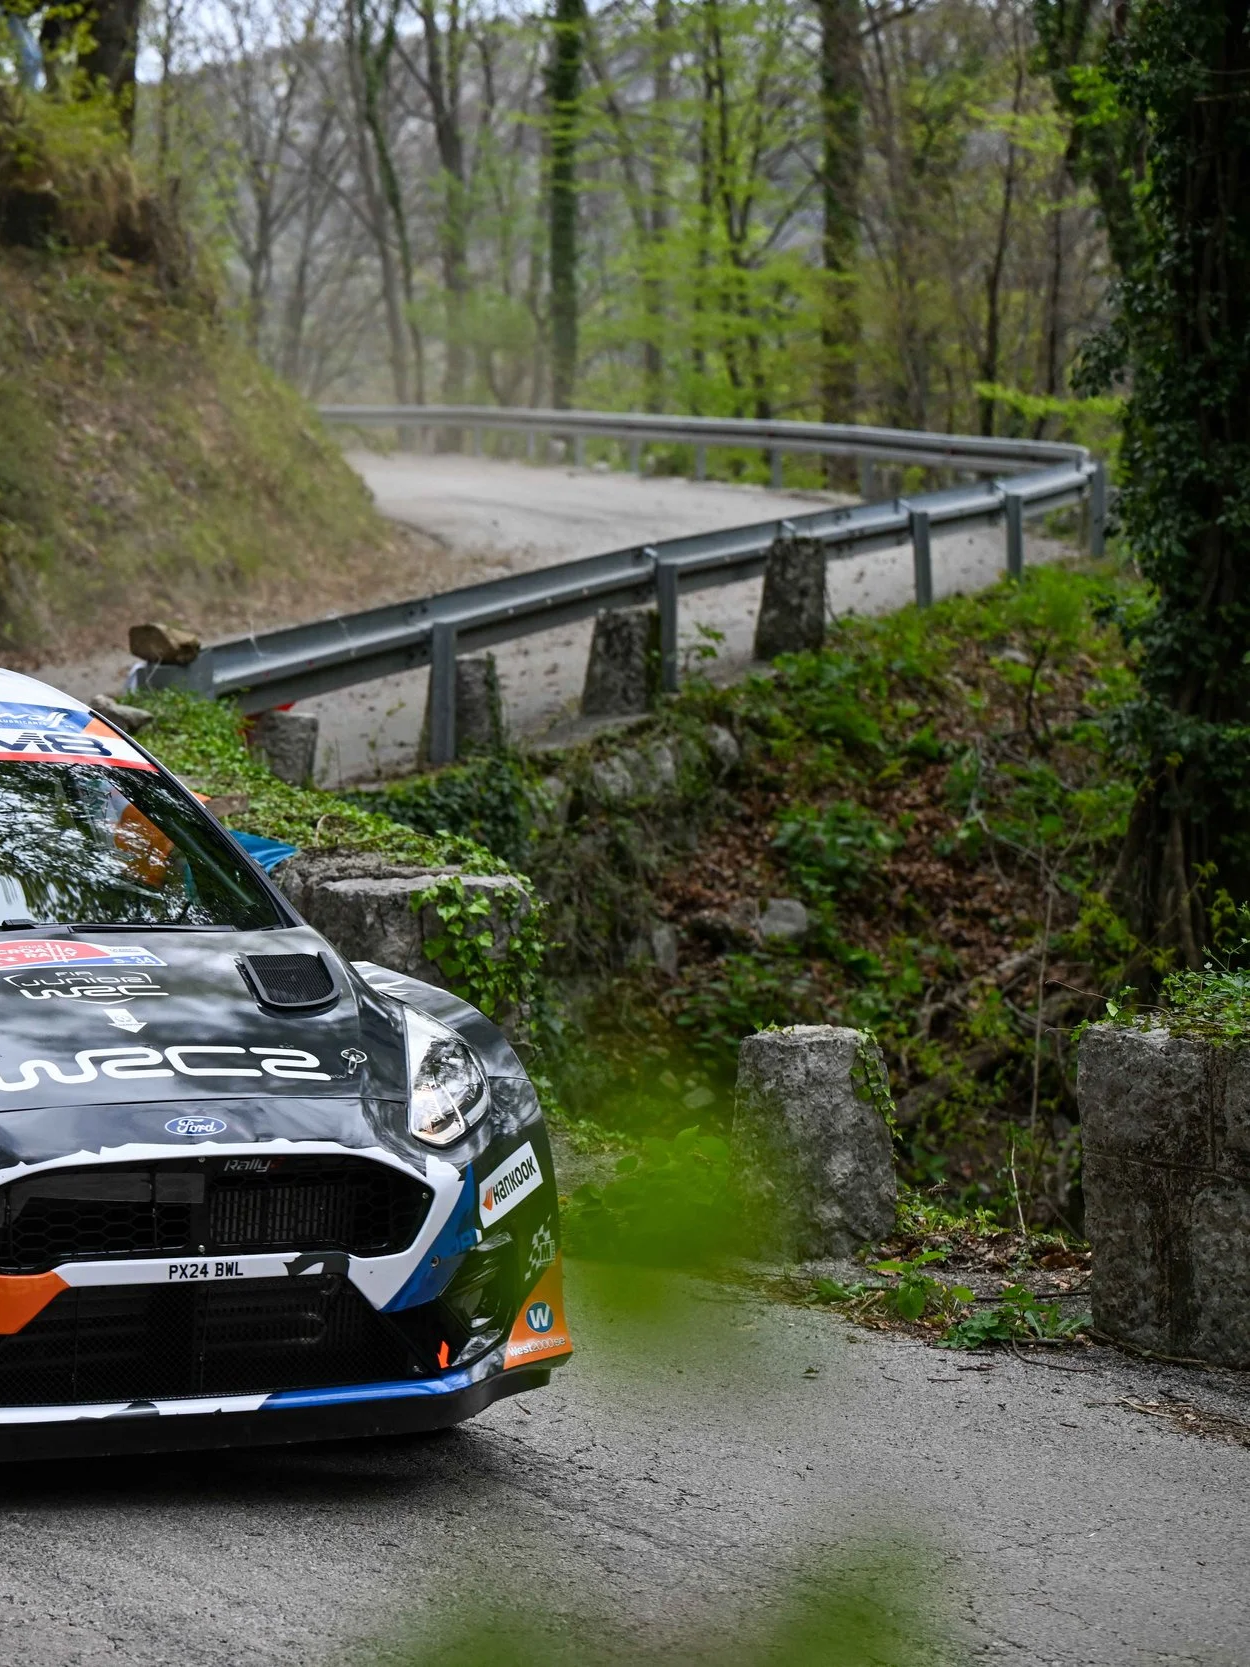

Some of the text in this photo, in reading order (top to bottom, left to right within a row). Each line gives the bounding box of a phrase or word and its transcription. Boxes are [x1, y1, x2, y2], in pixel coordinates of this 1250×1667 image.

[22, 976, 146, 987] JUNIOR
[19, 985, 170, 1000] WRC
[176, 1118, 217, 1134] Ford
[169, 1262, 244, 1279] PX24 BWL
[528, 1304, 551, 1330] W
